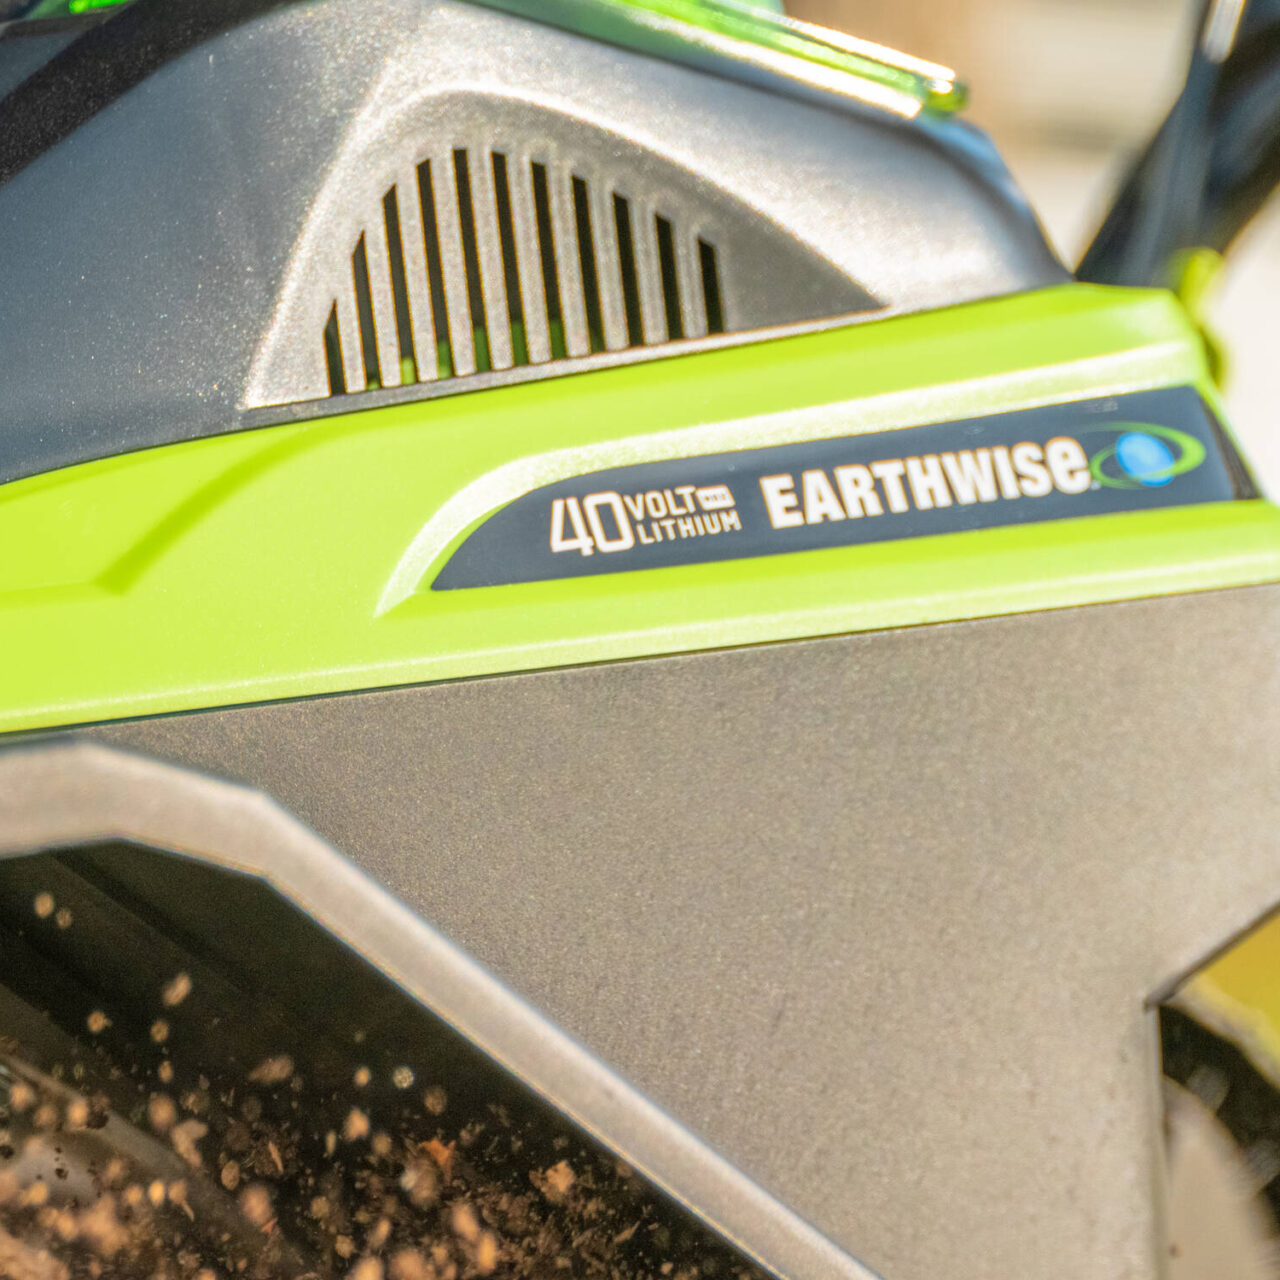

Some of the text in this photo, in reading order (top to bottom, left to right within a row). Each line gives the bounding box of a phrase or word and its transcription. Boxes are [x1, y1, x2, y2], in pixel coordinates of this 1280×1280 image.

[550, 485, 696, 556] 40 VOLT
[636, 509, 742, 544] LITHIUM
